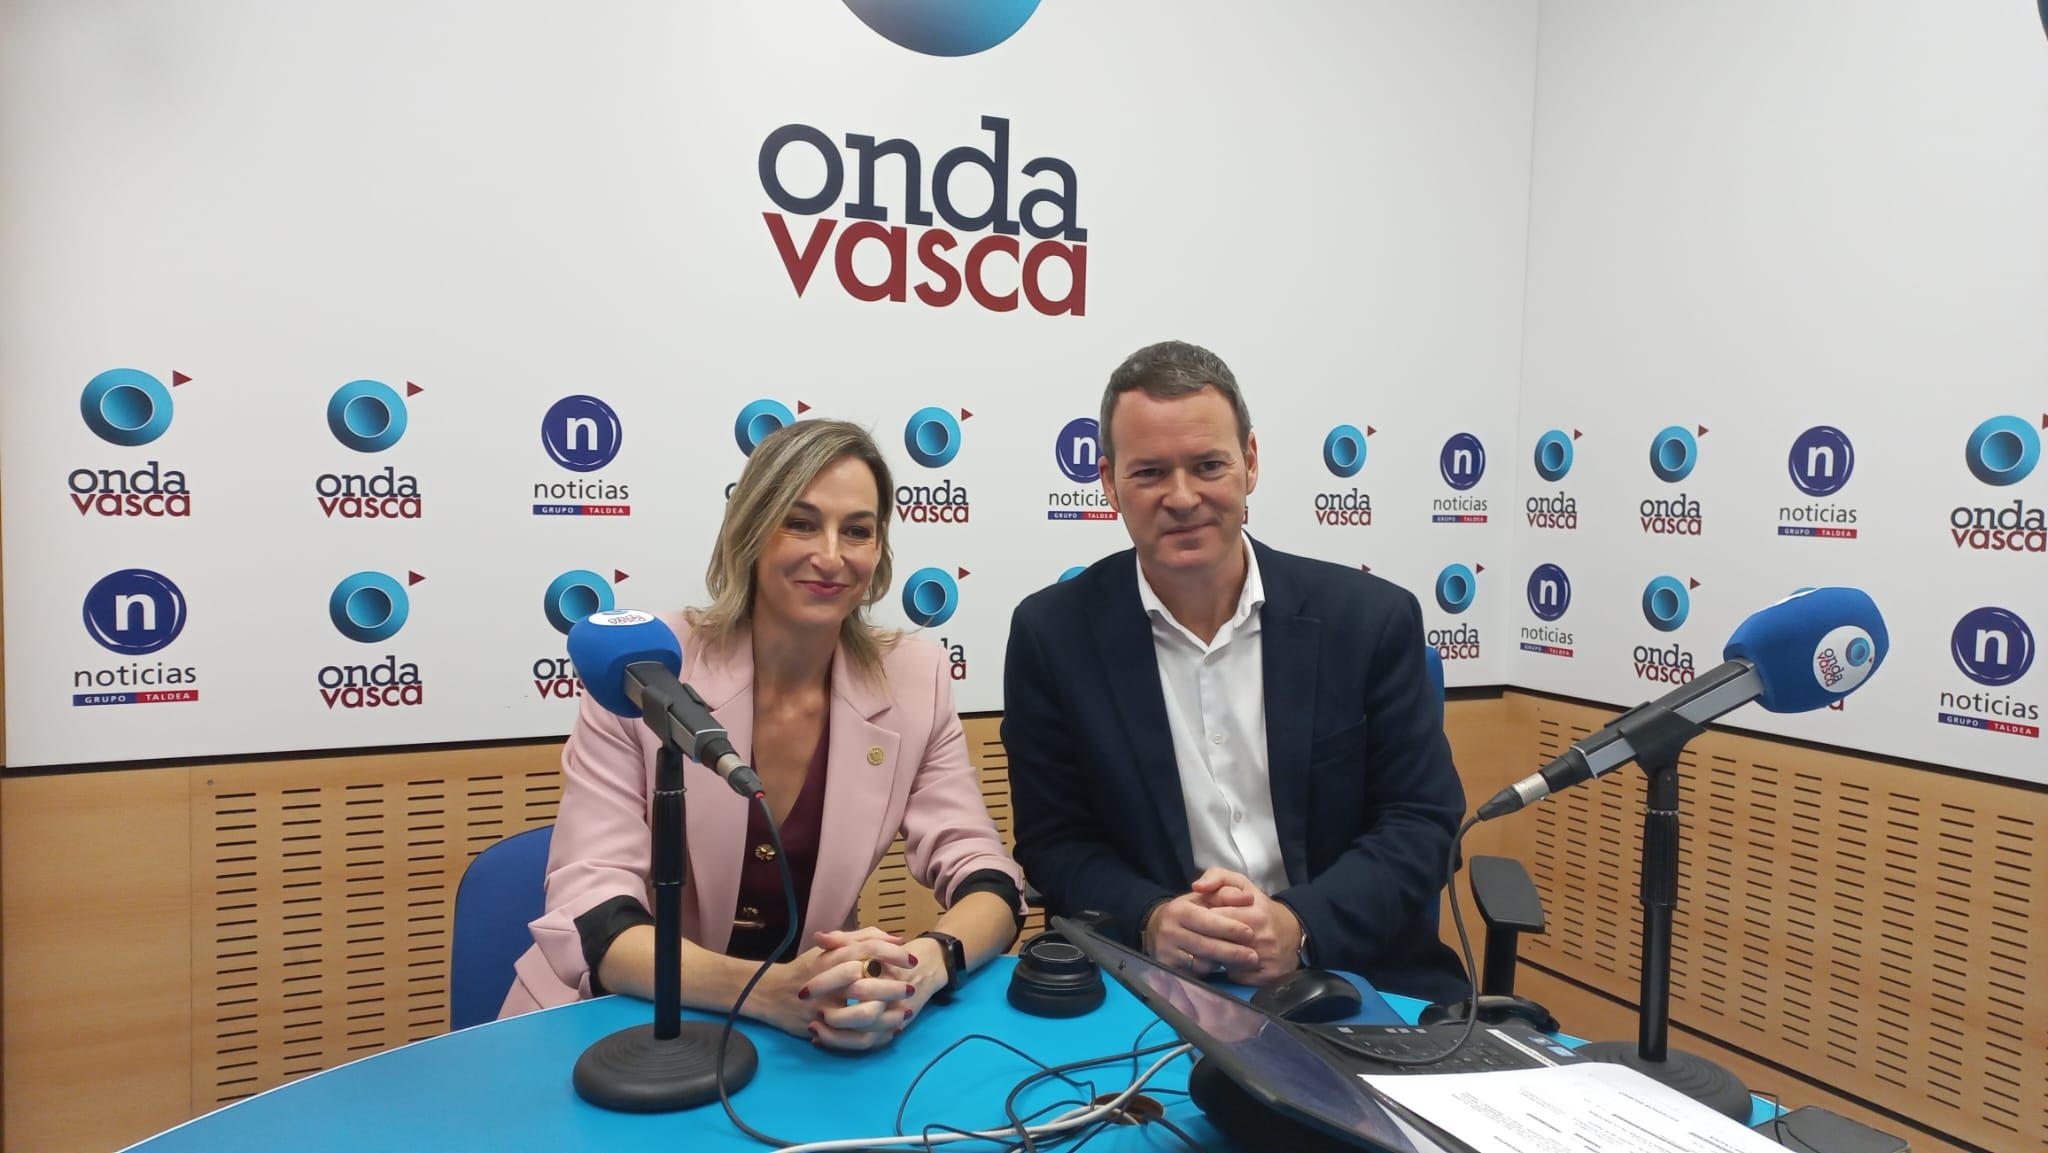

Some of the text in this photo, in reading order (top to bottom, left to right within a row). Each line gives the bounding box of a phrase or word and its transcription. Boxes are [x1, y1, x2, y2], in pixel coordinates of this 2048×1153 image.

[758, 115, 1088, 242] onda
[762, 211, 1088, 317] vasca
[566, 417, 598, 451] n
[1073, 436, 1097, 465] n
[1453, 449, 1472, 475] n
[1807, 445, 1834, 477] n
[68, 461, 190, 494] onda
[316, 466, 421, 498] onda
[534, 479, 629, 500] noticias
[895, 479, 969, 506] onda
[1048, 489, 1110, 506] noticia
[1315, 488, 1371, 510] onda
[1433, 496, 1487, 511] noticias
[1526, 491, 1577, 514] onda
[70, 493, 191, 517] vasca
[317, 496, 422, 518] vasca
[541, 506, 624, 515] GRUPO TALDEA
[896, 505, 969, 523] vasca
[1640, 493, 1702, 519] onda
[1779, 503, 1857, 523] noticias
[1950, 499, 2047, 531] onda
[1315, 510, 1371, 526] vasca
[1527, 512, 1577, 530] vasca
[1640, 516, 1702, 535] vasca
[1821, 529, 1851, 537] TALDEA
[1951, 528, 2047, 552] vasca
[1539, 579, 1558, 606] n
[115, 593, 156, 631] n
[1427, 623, 1480, 646] onda
[1521, 626, 1574, 645] noticias
[1633, 643, 1695, 670] onda
[1975, 629, 2008, 665] n
[74, 662, 197, 688] noticias
[318, 655, 422, 688] onda
[533, 658, 578, 680] on
[1634, 662, 1695, 685] vasca
[1816, 652, 1836, 687] vasca
[1824, 648, 1845, 682] onda
[84, 692, 191, 704] GRUPO TALDEA
[319, 685, 422, 710] vasca
[534, 679, 586, 699] vas
[1940, 692, 2039, 720] noticias
[1947, 715, 2032, 735] GRUPO TALDEA
